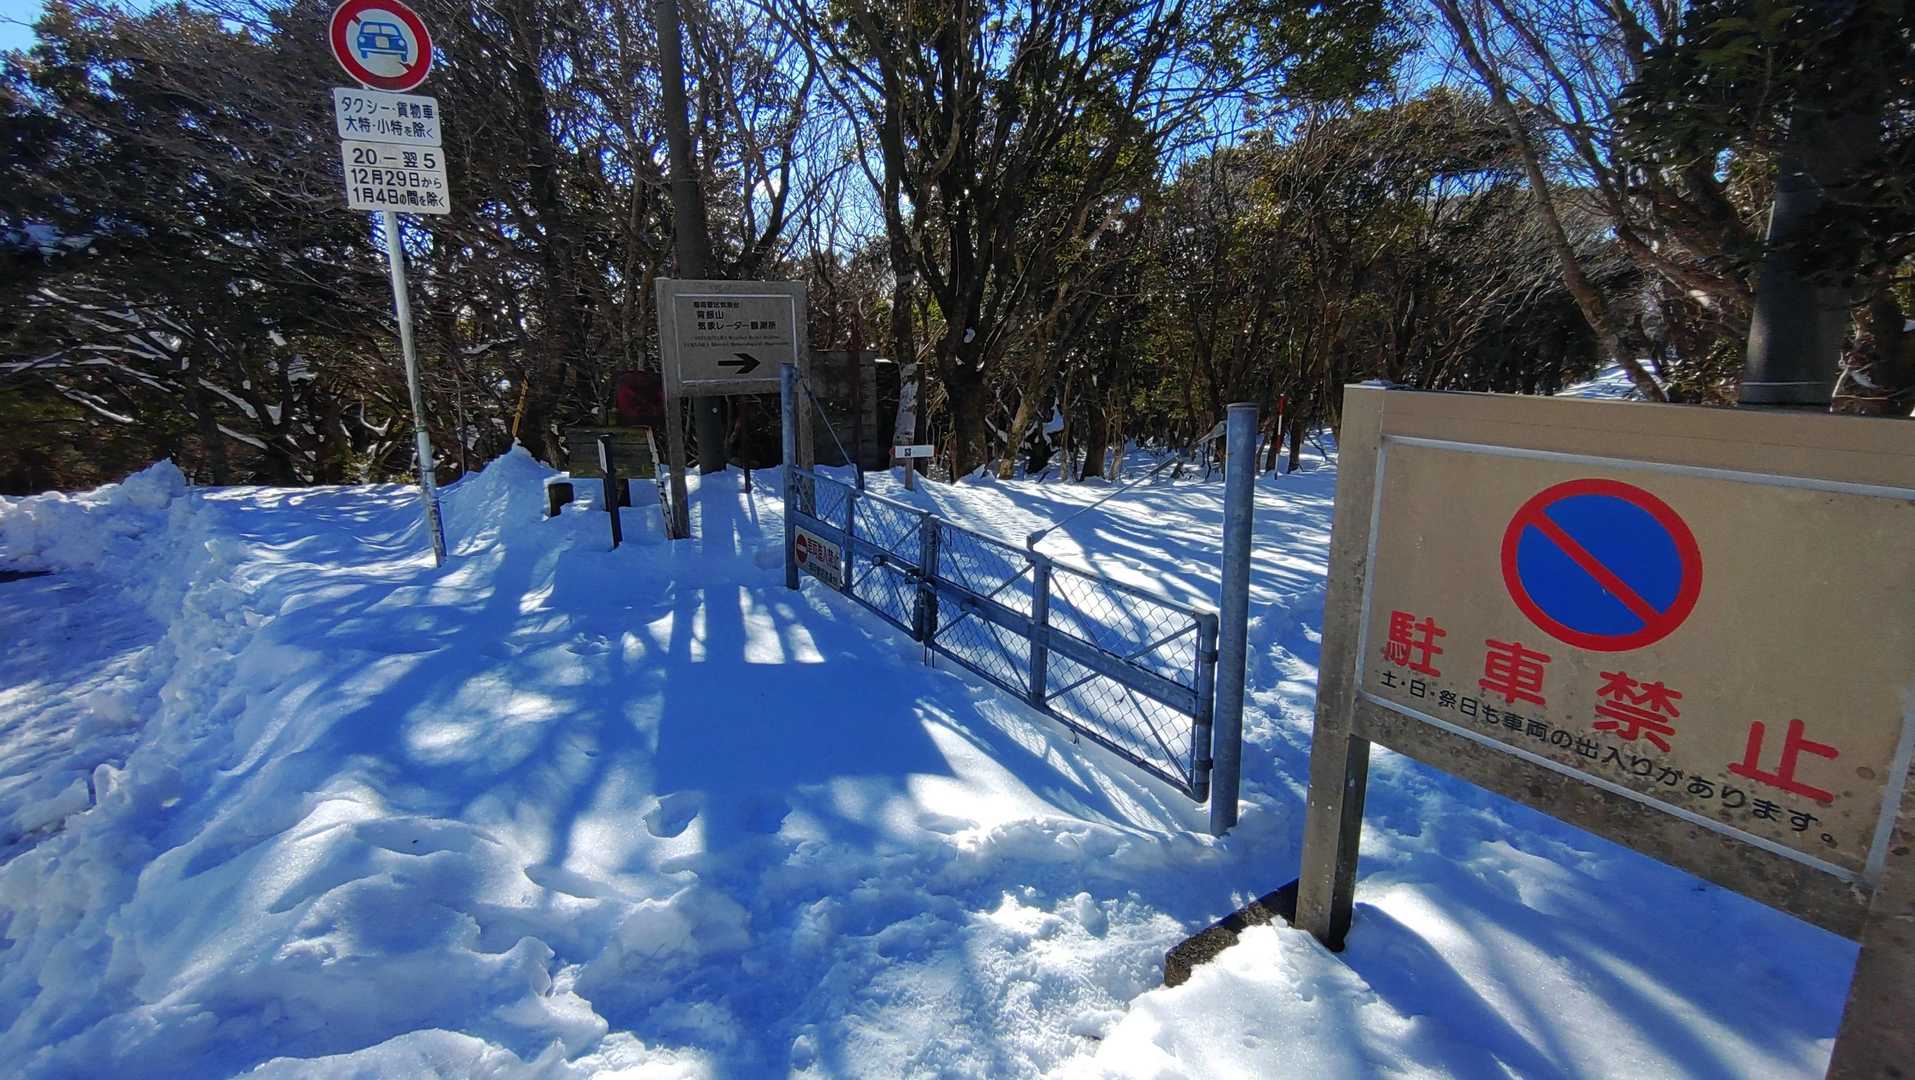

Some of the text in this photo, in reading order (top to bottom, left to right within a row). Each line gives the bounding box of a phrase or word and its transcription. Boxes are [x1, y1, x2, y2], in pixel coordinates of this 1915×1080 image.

[351, 168, 442, 189] 12月29日から
[353, 187, 445, 208] 1月4日の間を除く
[1383, 610, 1839, 802] 駐車禁止
